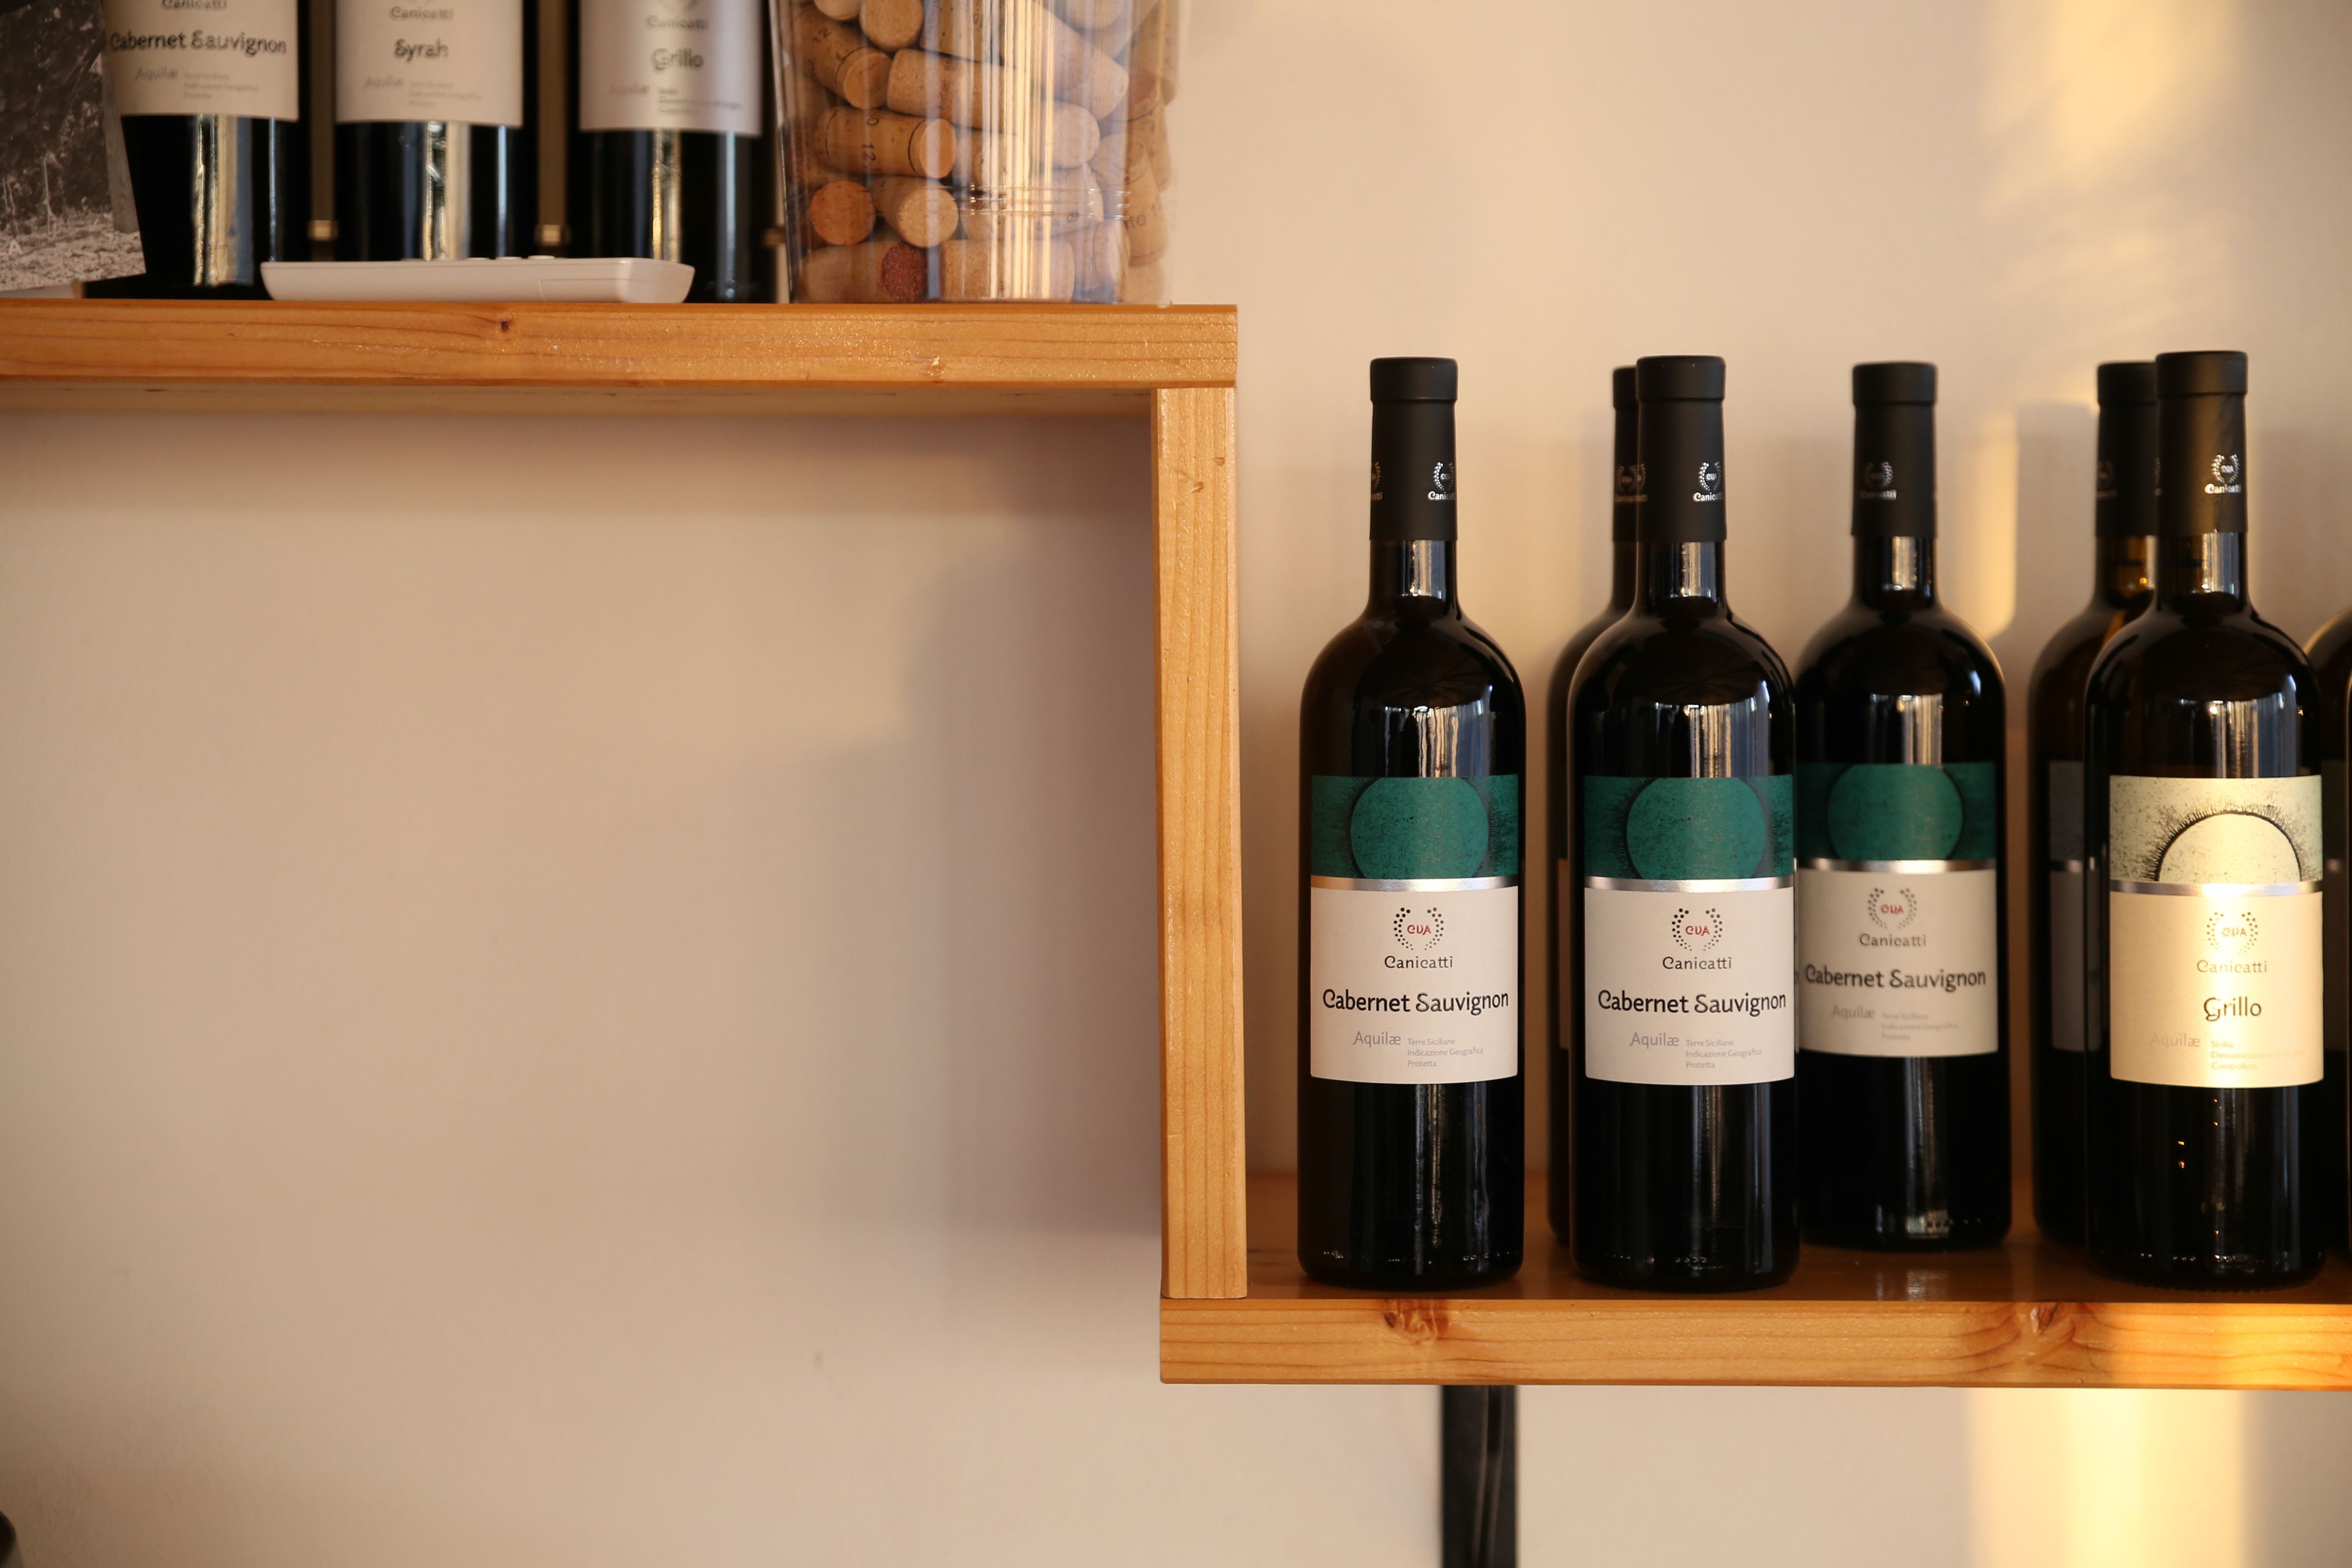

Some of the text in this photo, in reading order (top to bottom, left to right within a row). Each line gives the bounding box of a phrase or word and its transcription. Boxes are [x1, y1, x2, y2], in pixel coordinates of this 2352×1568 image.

[110, 30, 286, 56] Cabernet Sauvignon
[394, 38, 448, 62] Syrah
[652, 48, 703, 71] Grillo
[1805, 963, 1986, 992] Cabernet Sauvignon
[1322, 989, 1509, 1016] Cabernet Sauvignon
[1598, 989, 1786, 1017] Cabernet Sauvignon
[2203, 996, 2262, 1022] Grillo
[1449, 1047, 1483, 1057] Geografica
[1727, 1048, 1762, 1058] Geografica
